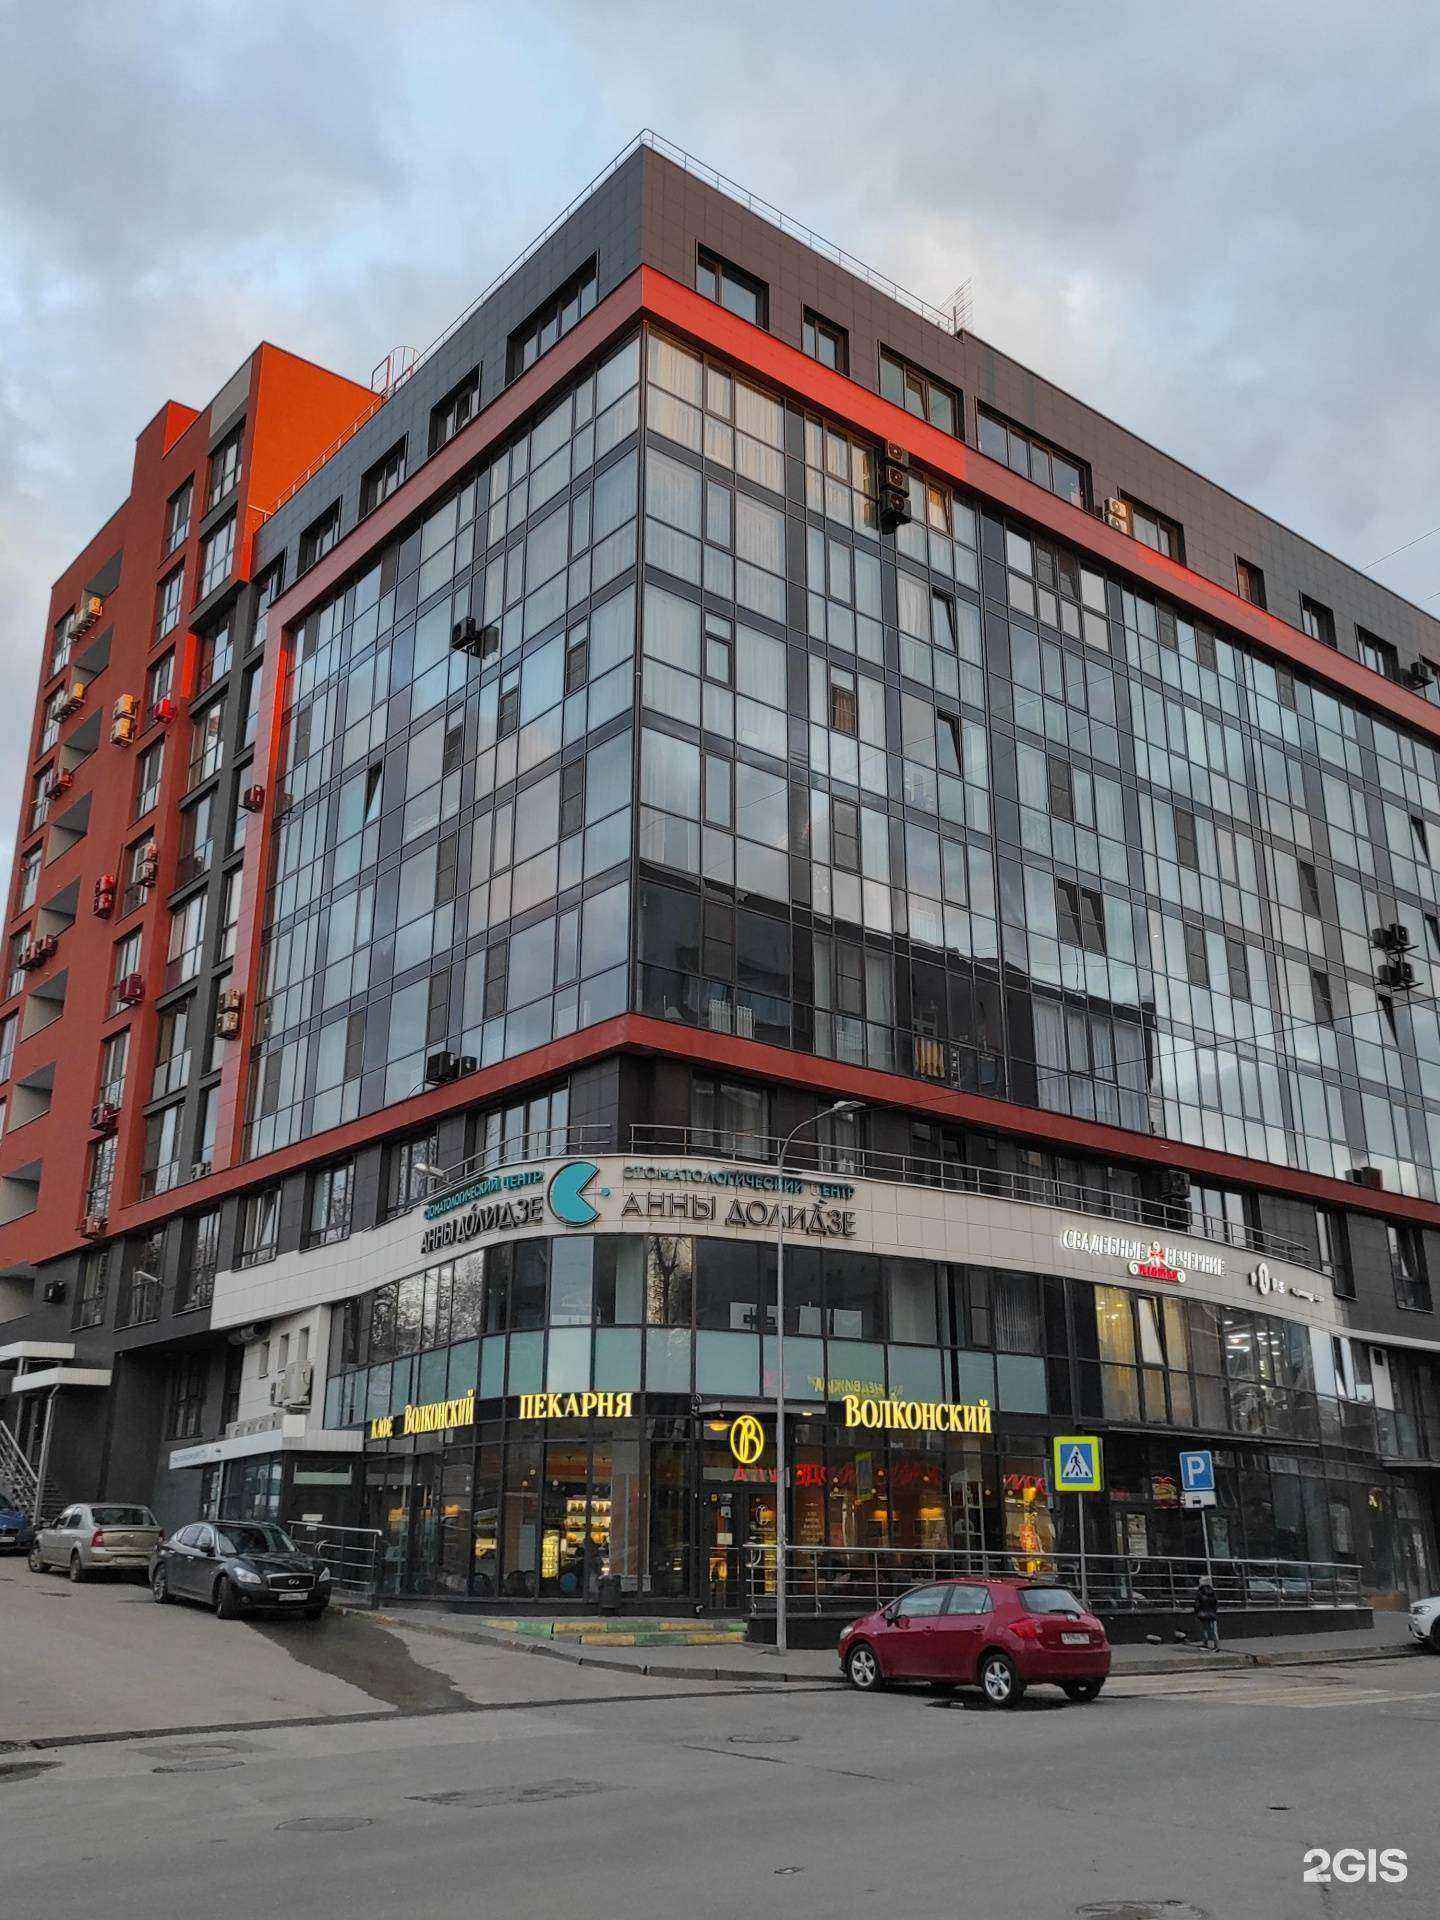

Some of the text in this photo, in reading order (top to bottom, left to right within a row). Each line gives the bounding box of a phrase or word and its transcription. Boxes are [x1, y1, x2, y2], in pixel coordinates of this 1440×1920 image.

[420, 1197, 544, 1254] АННЫ ДОЛИДЗЕ
[621, 1192, 857, 1236] АННЫ ДОЛИДЗЕ
[518, 1392, 633, 1420] ПЕКАРНЯ
[370, 1415, 394, 1439] КАФЕ
